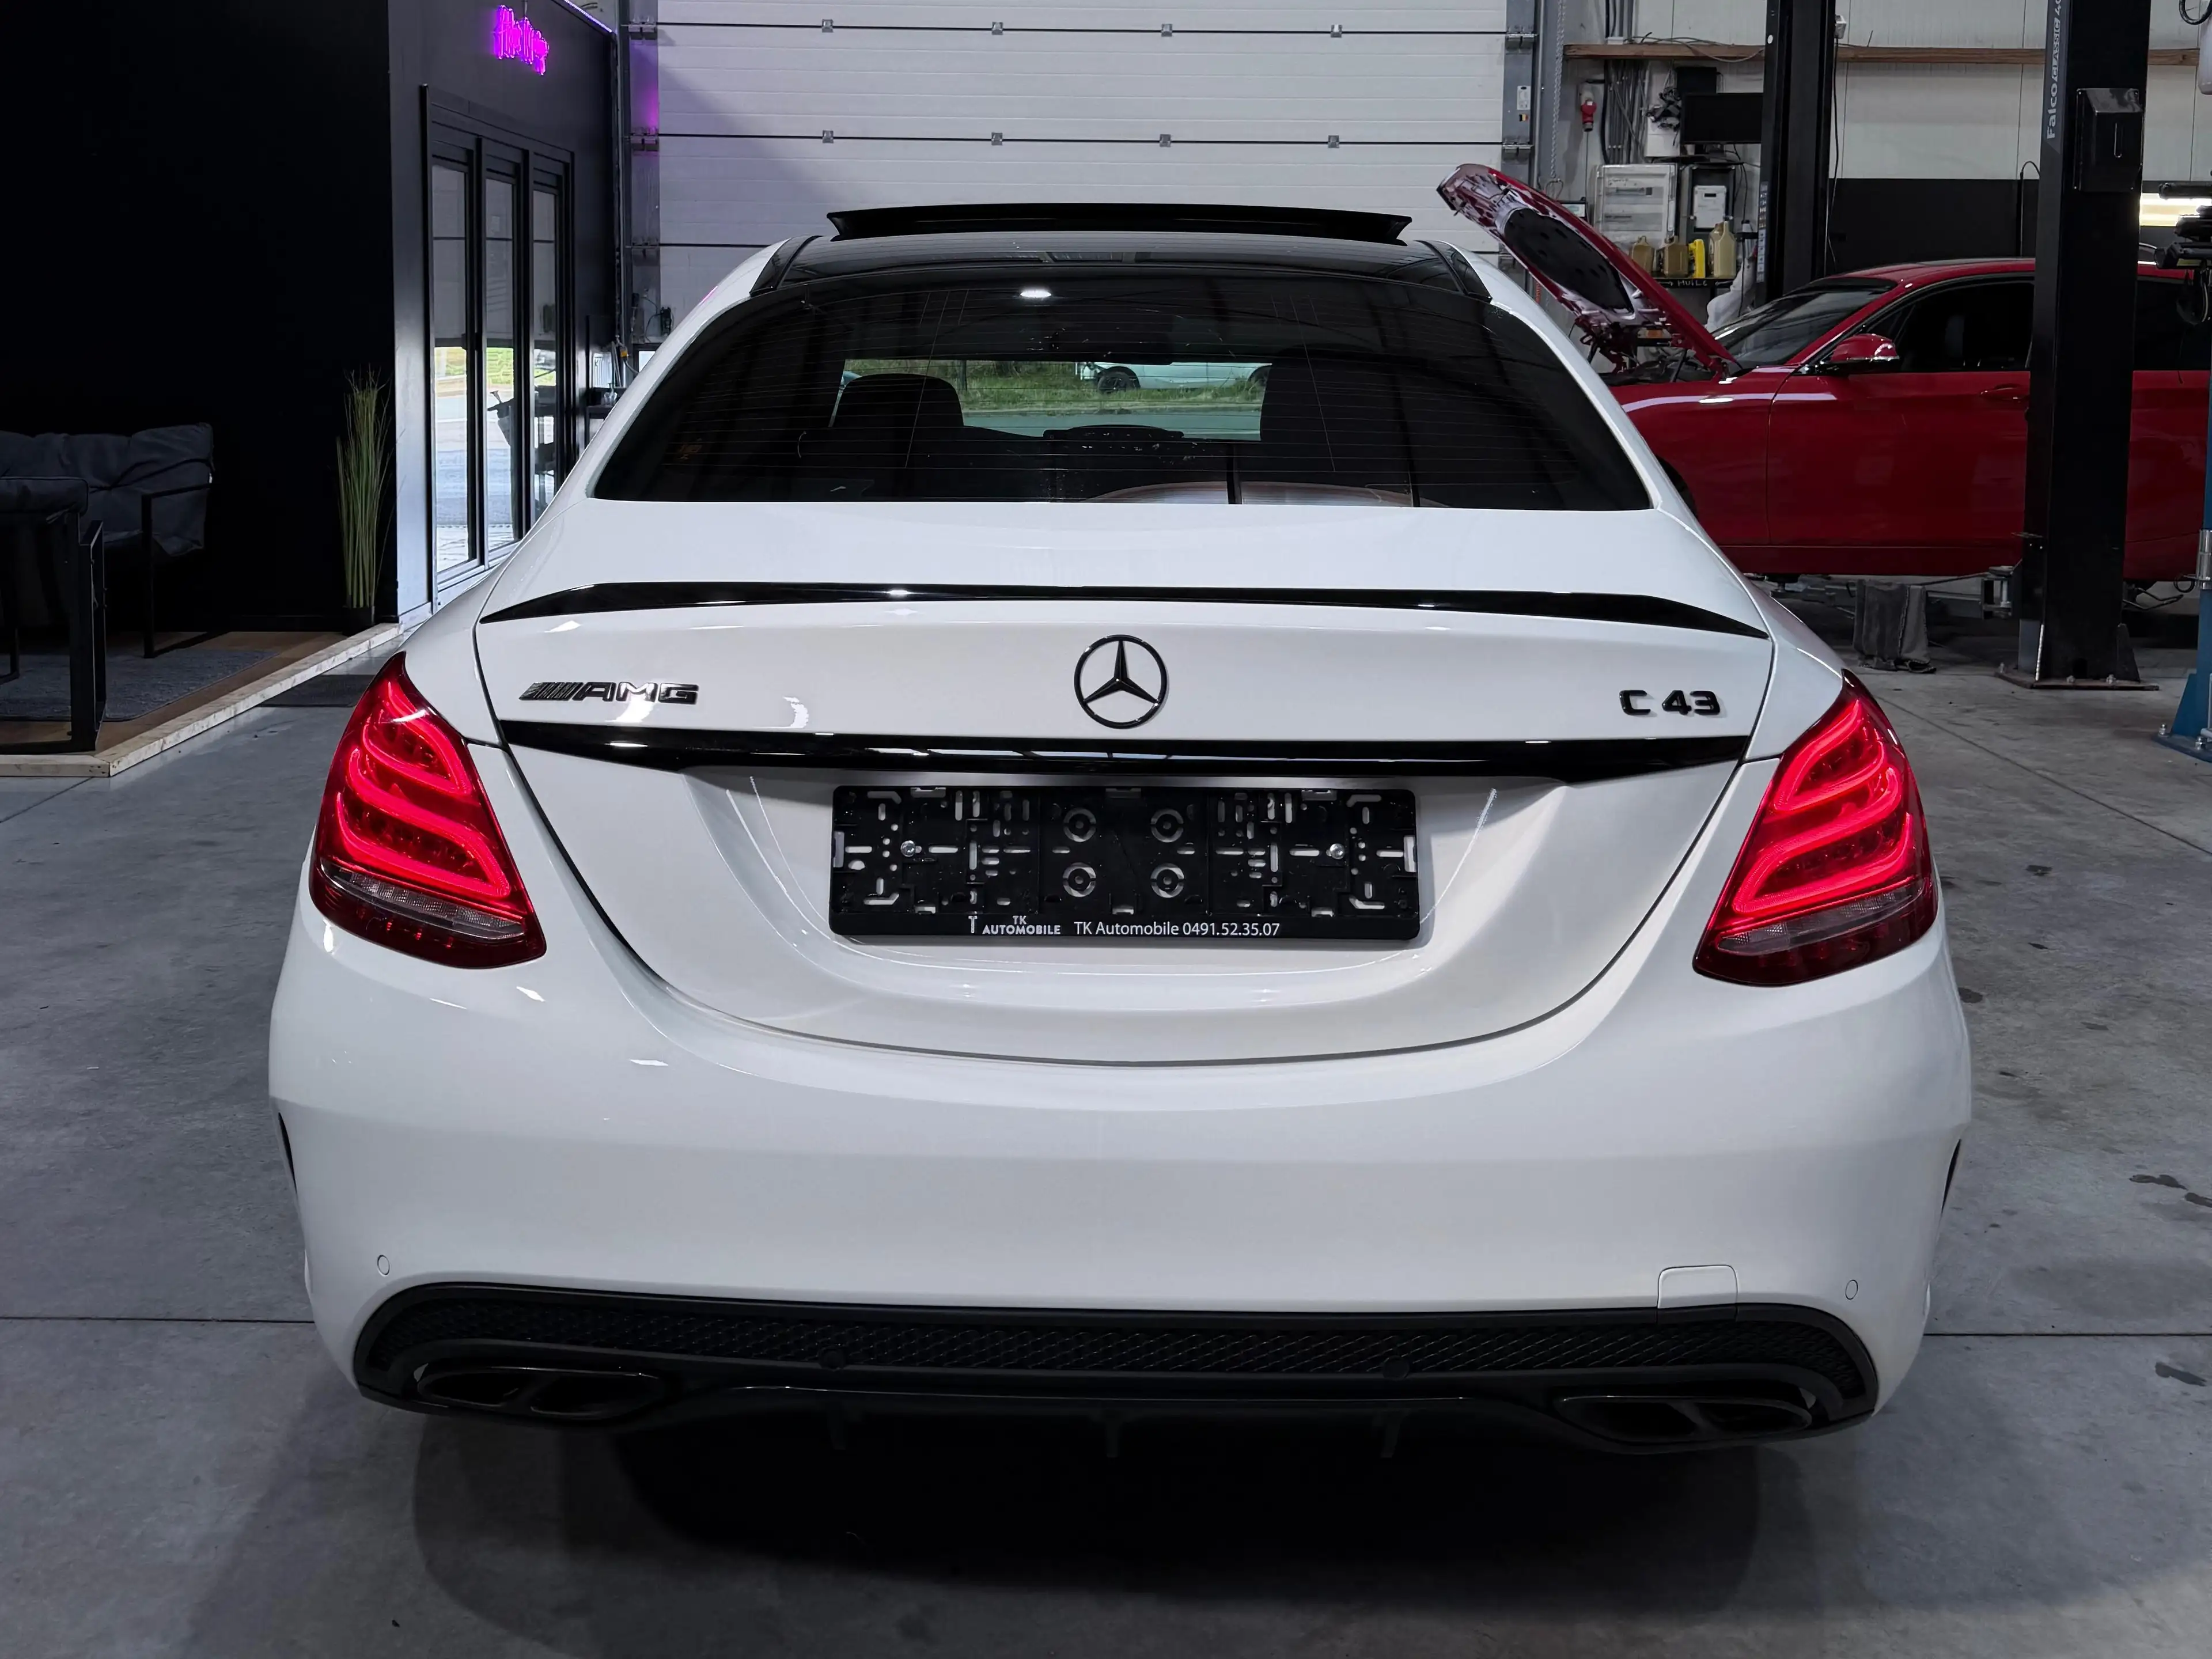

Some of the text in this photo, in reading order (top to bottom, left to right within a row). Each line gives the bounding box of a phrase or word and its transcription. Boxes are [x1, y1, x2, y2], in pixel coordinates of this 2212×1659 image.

[2051, 20, 2060, 79] CLASSIC
[2047, 83, 2057, 139] Falco
[1619, 690, 1721, 715] C 43
[982, 924, 1061, 935] AUTOMOBILE
[1012, 915, 1027, 925] TK
[1074, 921, 1281, 936] TK Automobile 0491.52.35.07
